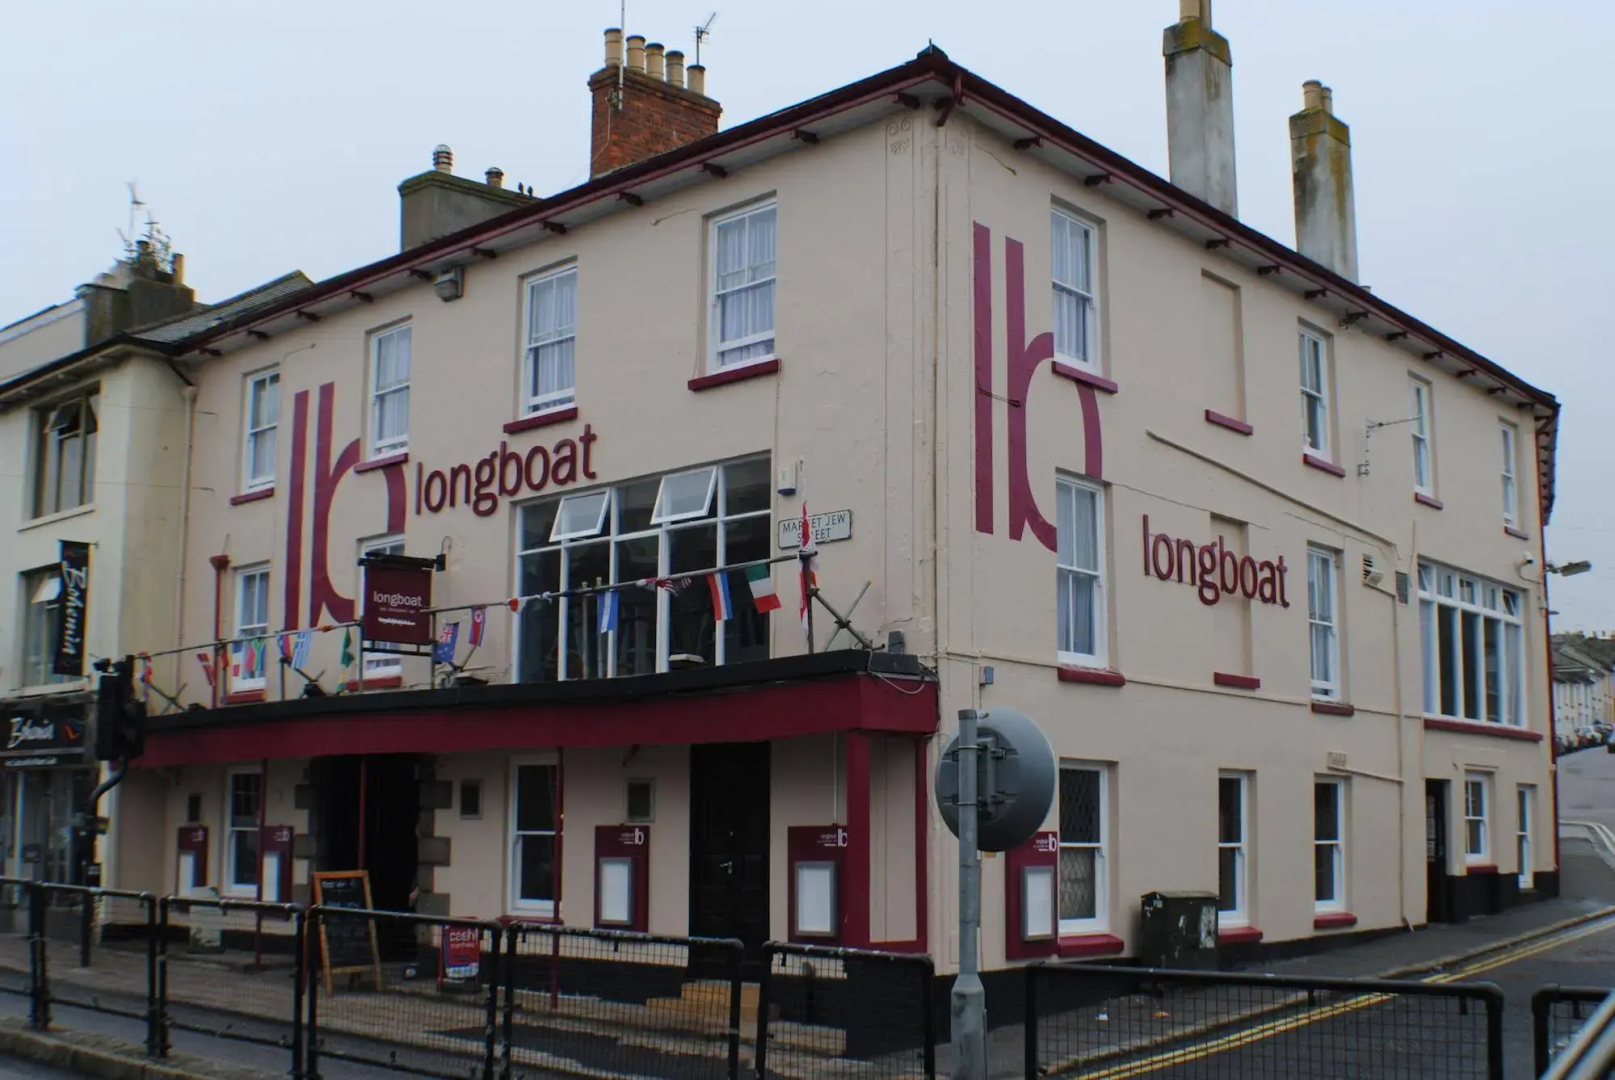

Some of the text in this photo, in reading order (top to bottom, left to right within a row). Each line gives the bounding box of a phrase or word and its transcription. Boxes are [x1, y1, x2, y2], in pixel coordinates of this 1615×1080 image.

[415, 423, 597, 517] longboat
[782, 513, 846, 534] MARET JEW
[797, 527, 831, 543] SEET
[1142, 513, 1290, 608] longboat
[61, 560, 88, 656] Bohemia
[373, 590, 422, 607] longboat
